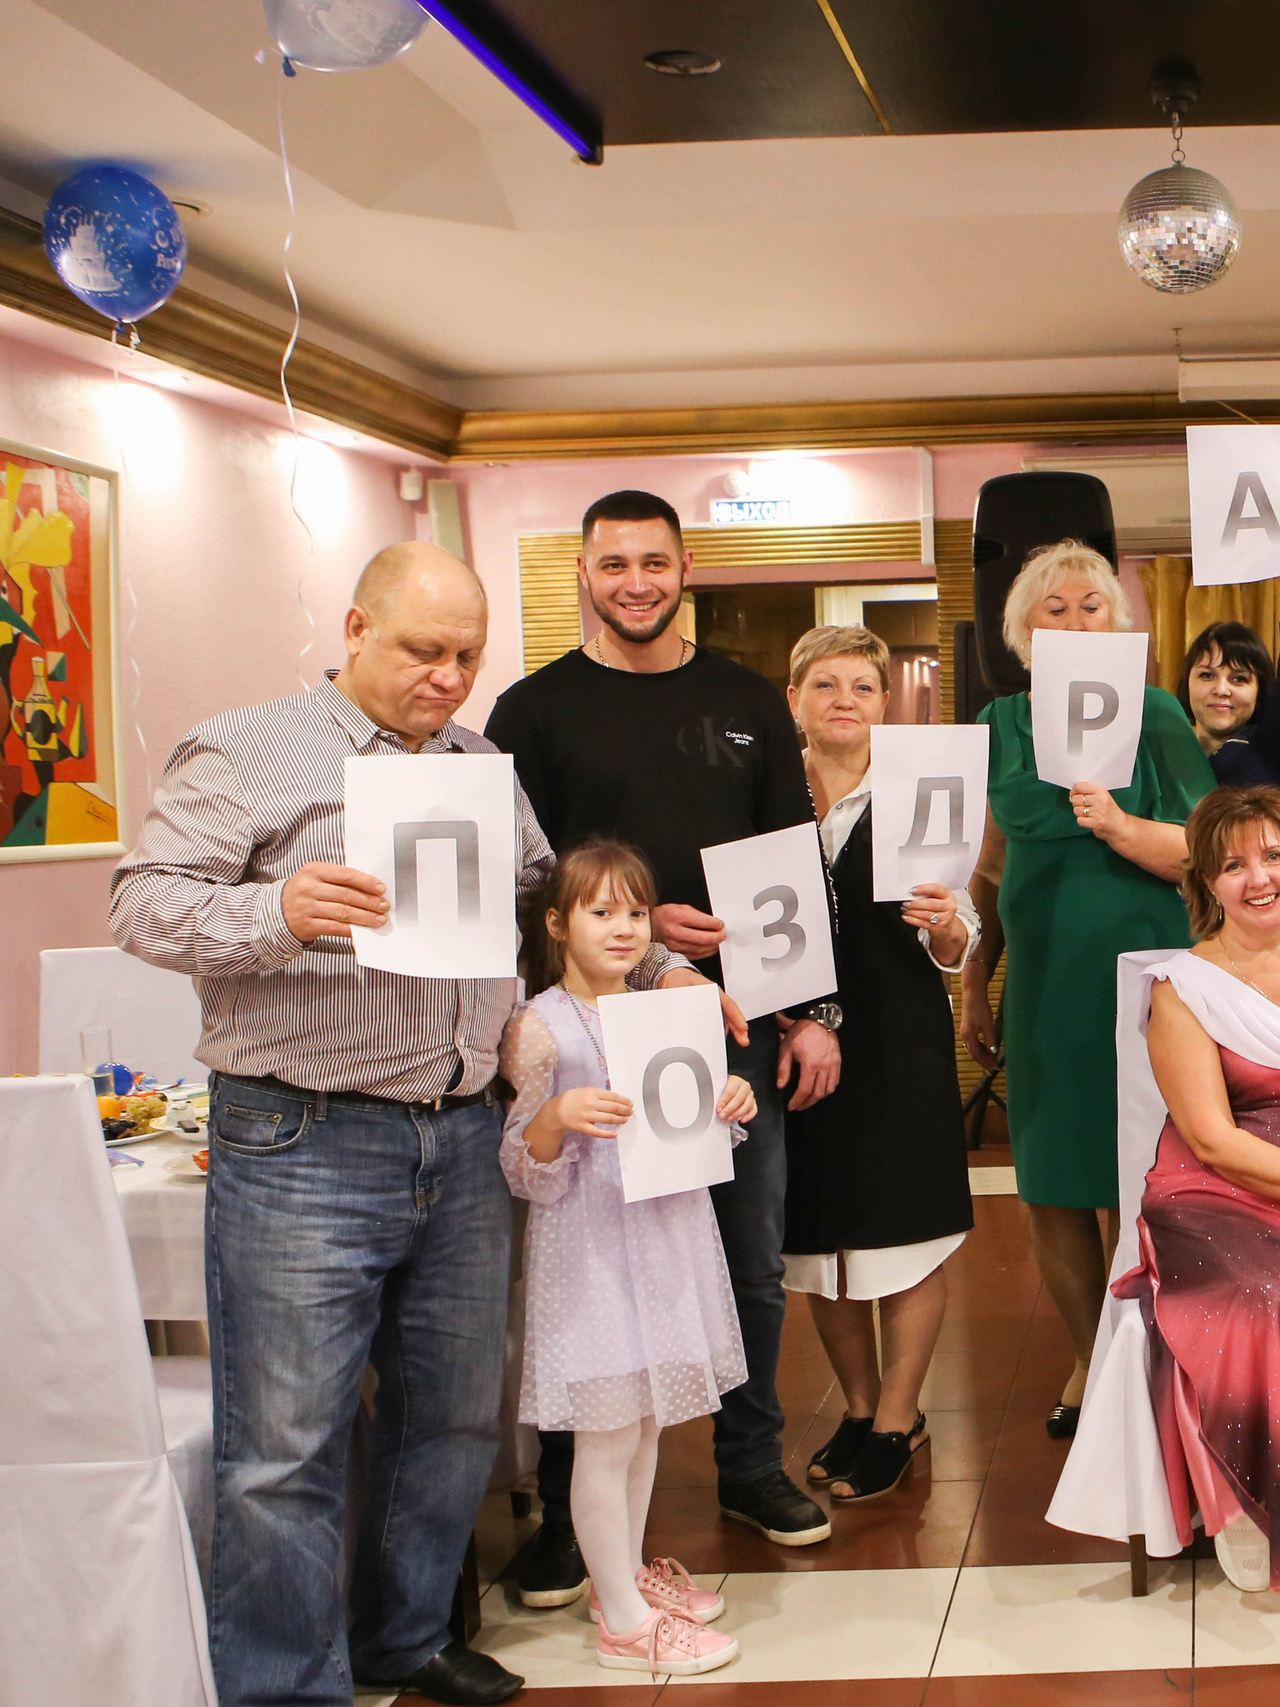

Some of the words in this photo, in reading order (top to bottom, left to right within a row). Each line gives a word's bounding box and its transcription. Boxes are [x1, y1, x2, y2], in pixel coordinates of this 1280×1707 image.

[717, 501, 791, 522] ВЫХОД
[1067, 680, 1120, 756] Р
[393, 820, 481, 927] П
[898, 776, 970, 881] Д
[752, 884, 807, 972] З
[642, 1046, 714, 1142] О
